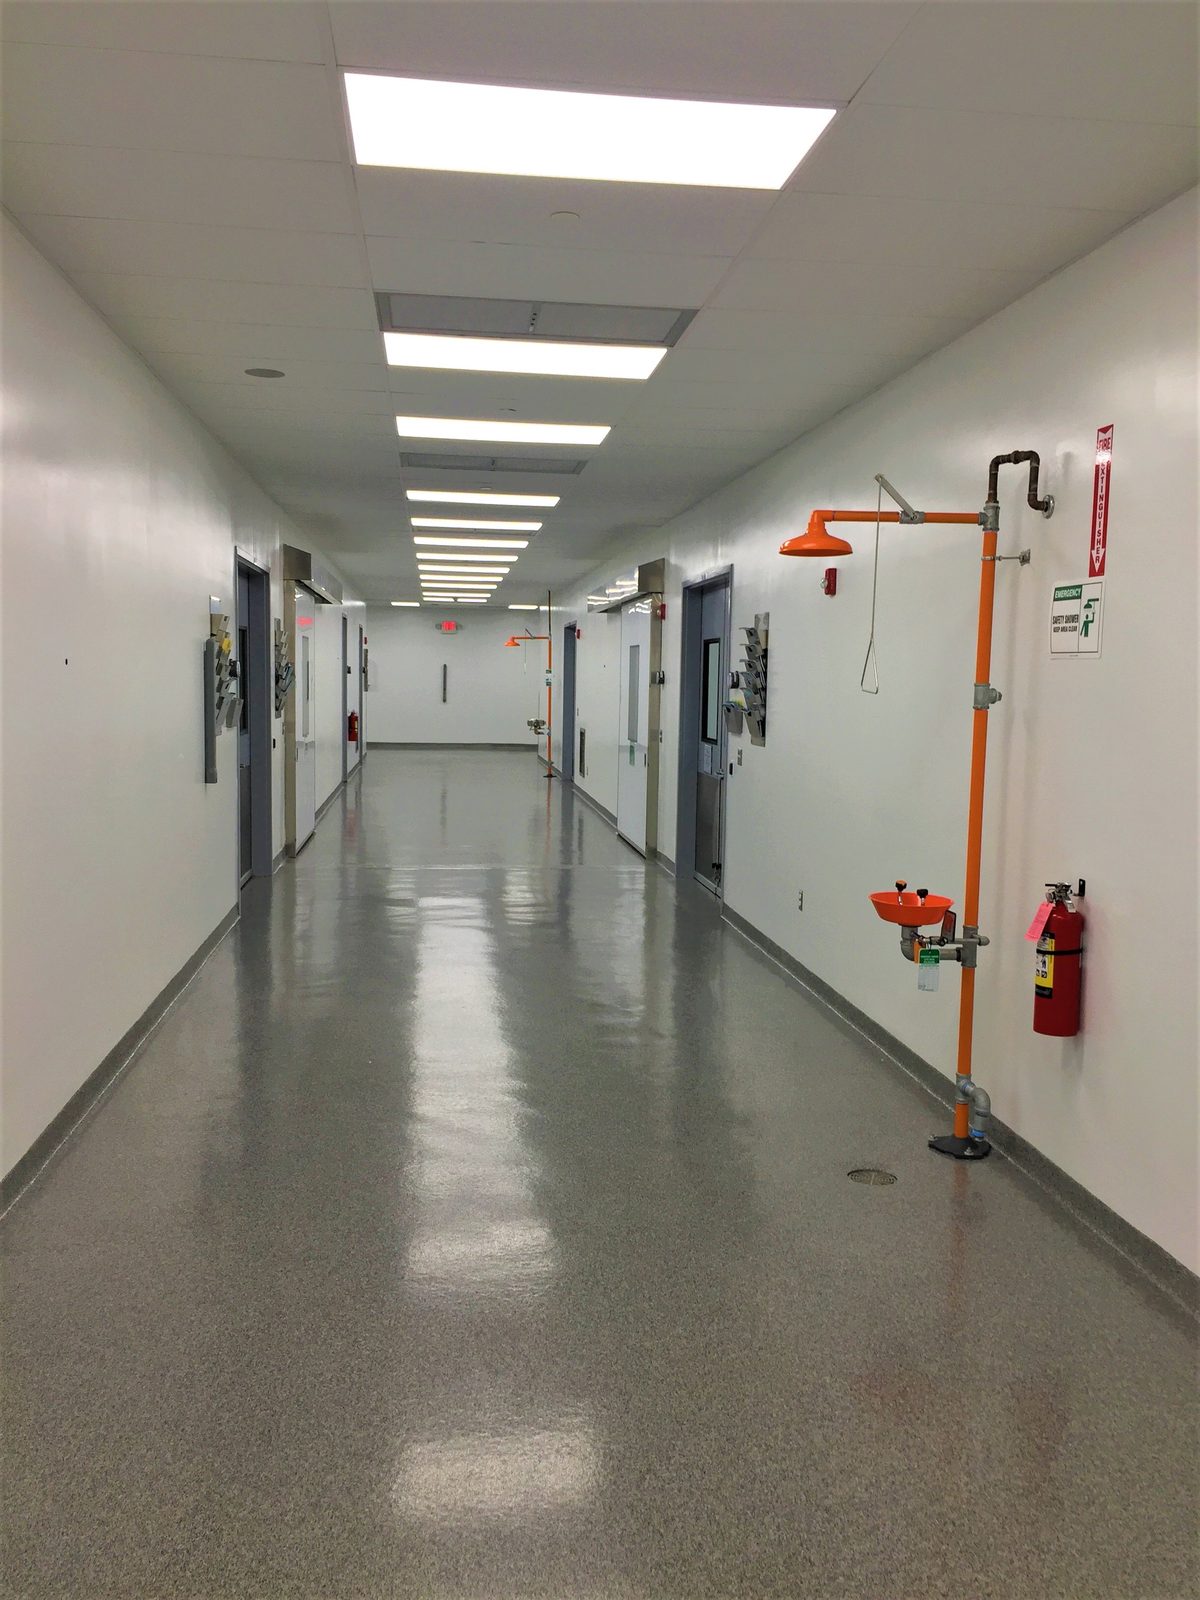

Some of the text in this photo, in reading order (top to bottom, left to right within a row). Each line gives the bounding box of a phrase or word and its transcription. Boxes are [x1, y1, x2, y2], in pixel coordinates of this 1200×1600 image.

[1098, 437, 1111, 451] FIRE
[1055, 588, 1081, 599] EMERGENCY
[1053, 614, 1079, 624] SAFETY SHOWER
